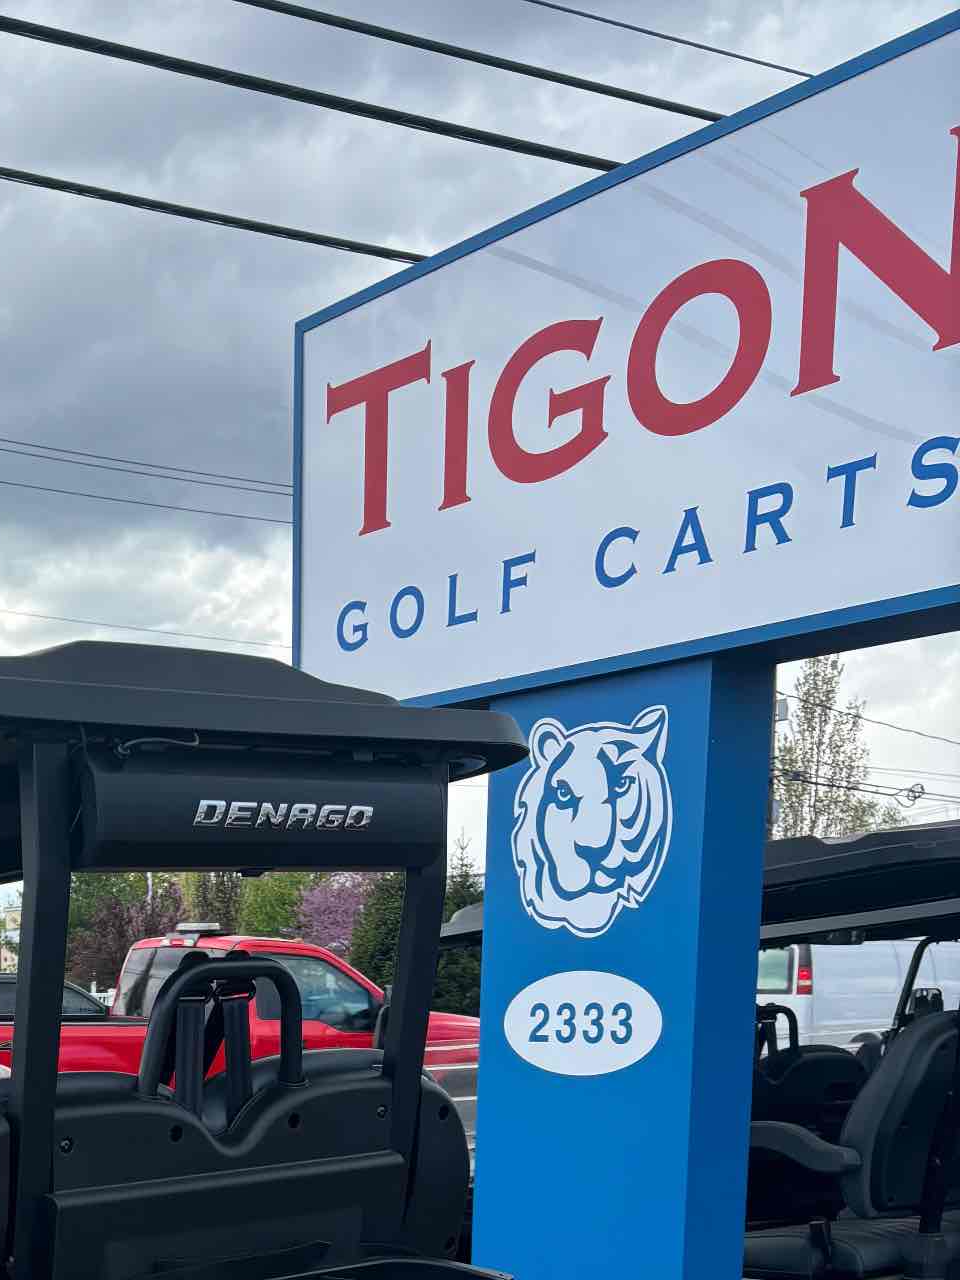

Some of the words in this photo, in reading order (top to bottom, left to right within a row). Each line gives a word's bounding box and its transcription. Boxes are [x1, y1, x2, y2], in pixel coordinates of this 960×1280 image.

[326, 124, 960, 537] TIGON
[336, 550, 537, 652] GOLF
[594, 436, 960, 589] CARTS
[193, 799, 374, 829] DENAGO
[528, 1002, 633, 1045] 2333
